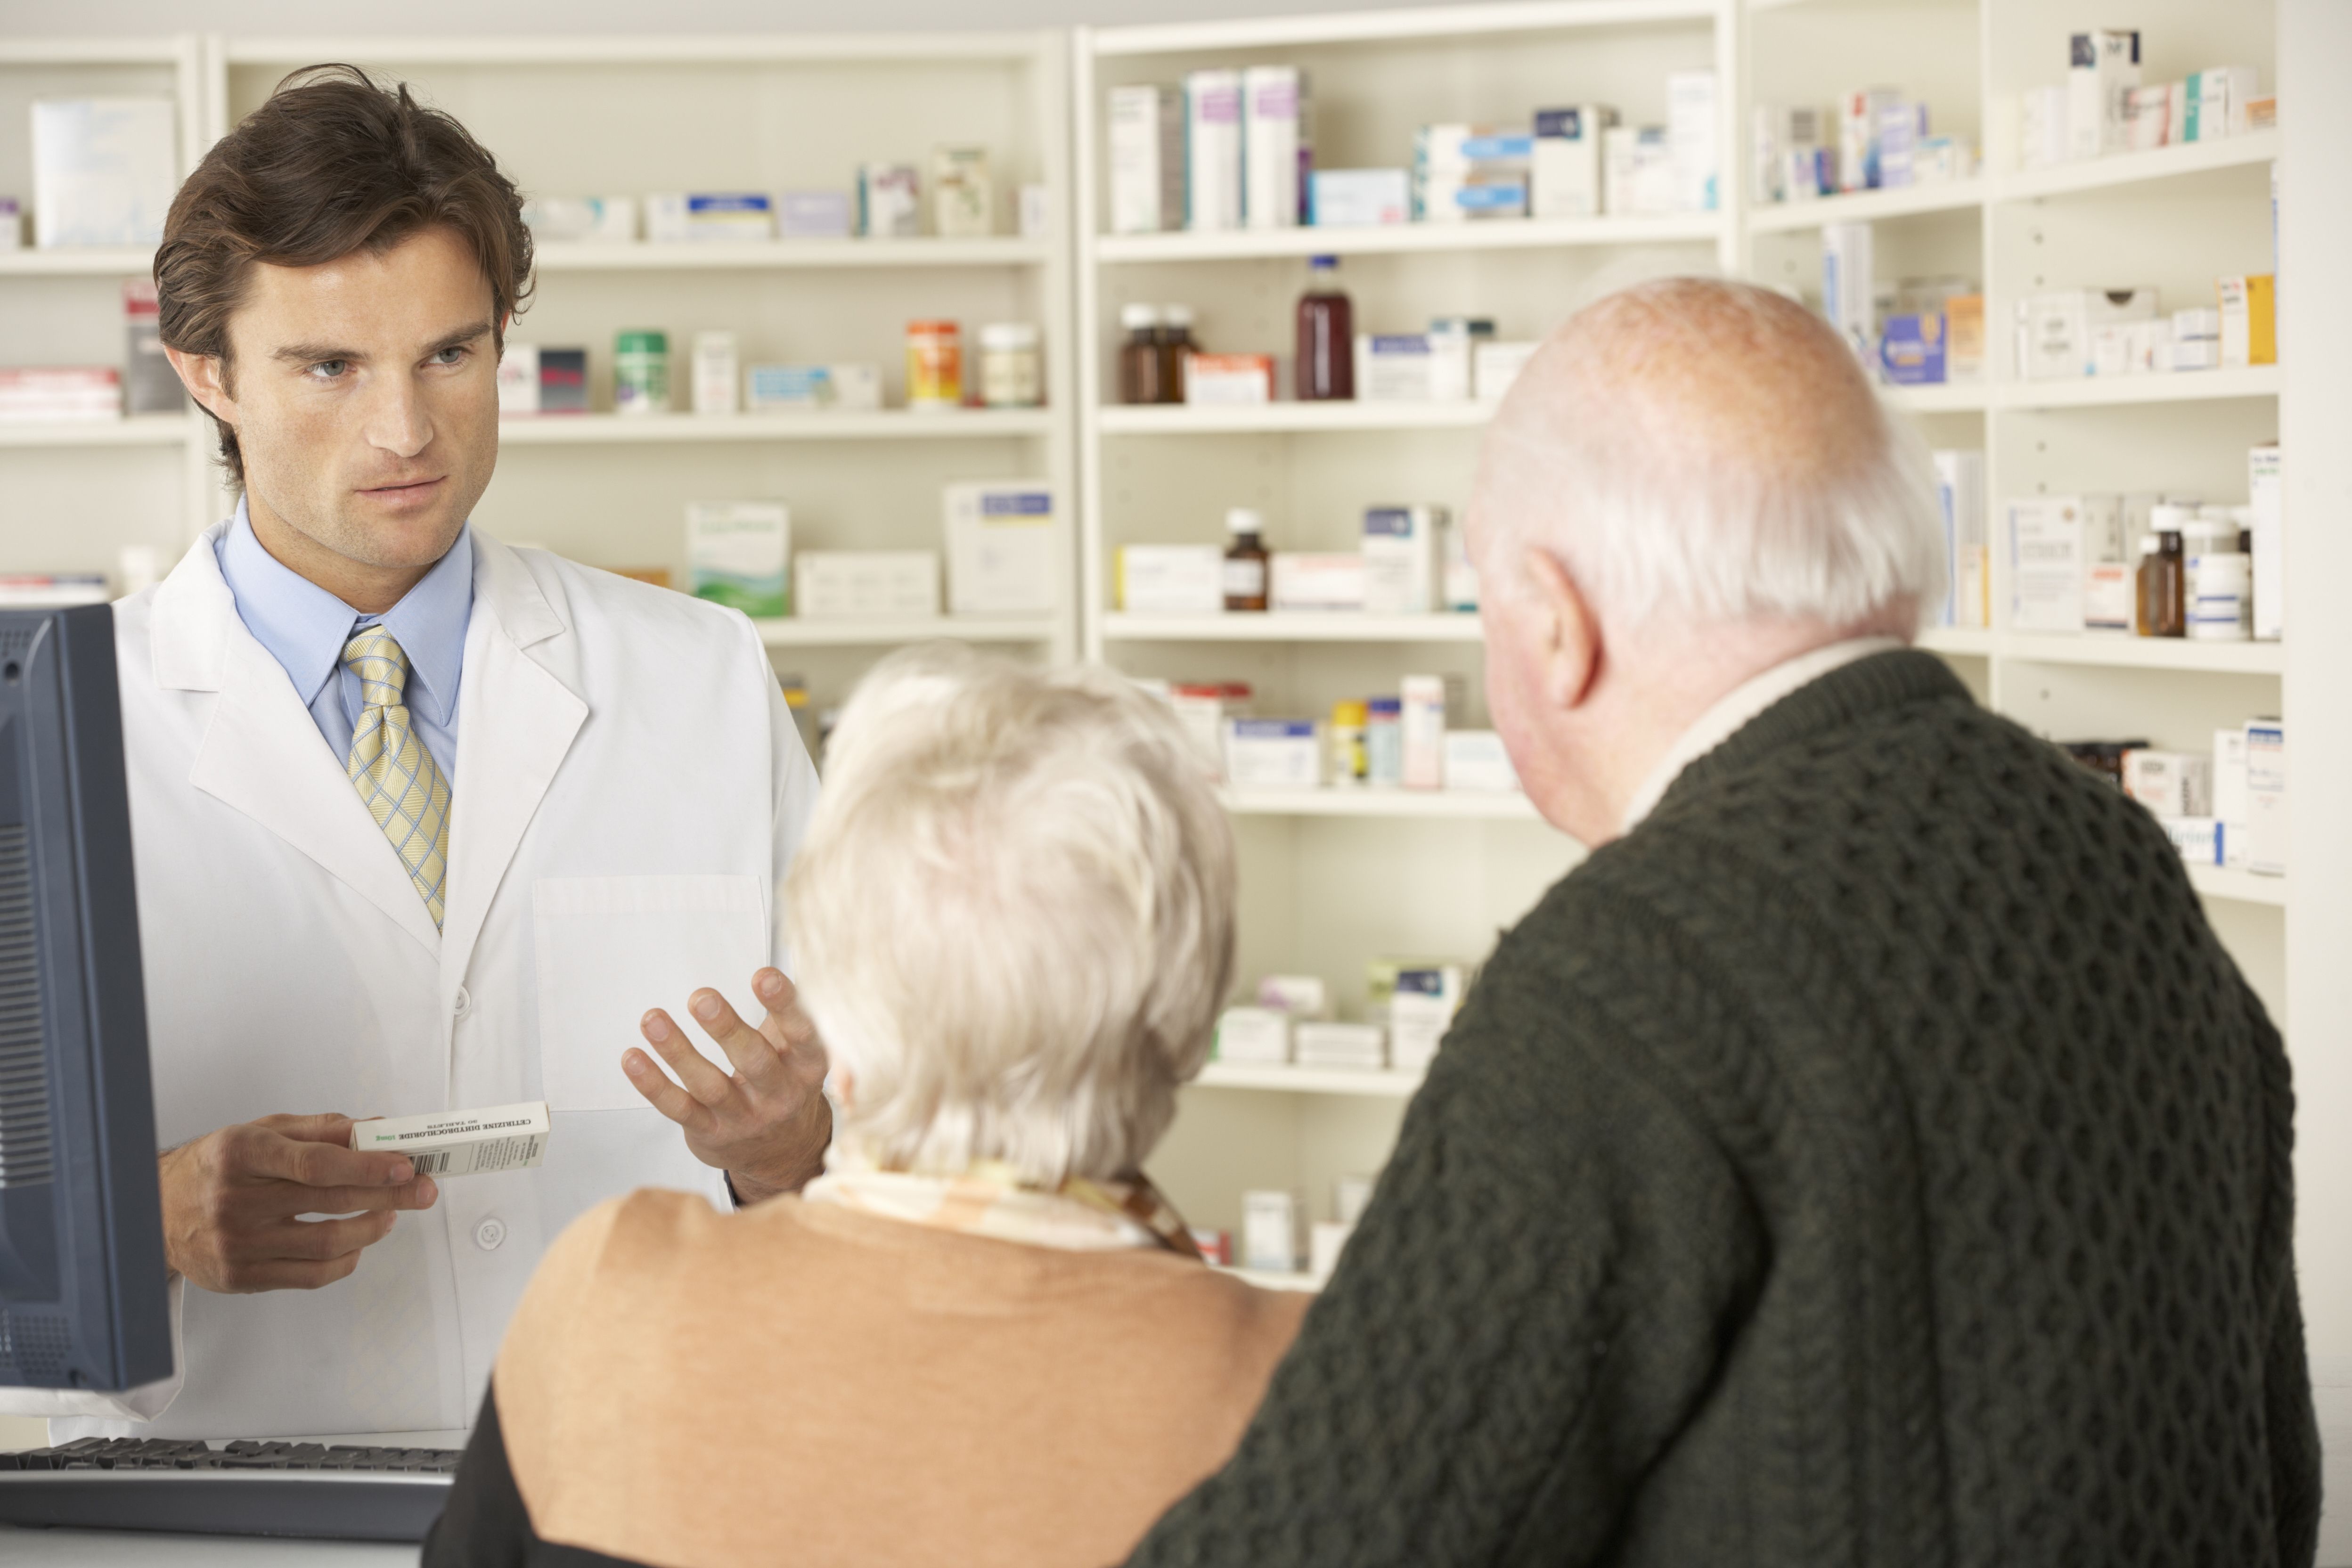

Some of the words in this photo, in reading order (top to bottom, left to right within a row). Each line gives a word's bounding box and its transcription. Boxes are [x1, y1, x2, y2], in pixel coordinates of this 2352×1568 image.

[427, 1121, 466, 1129] TABLETS
[483, 1119, 531, 1130] CETIRIZINE
[399, 1125, 480, 1140] DIHYDROCHLORIDE
